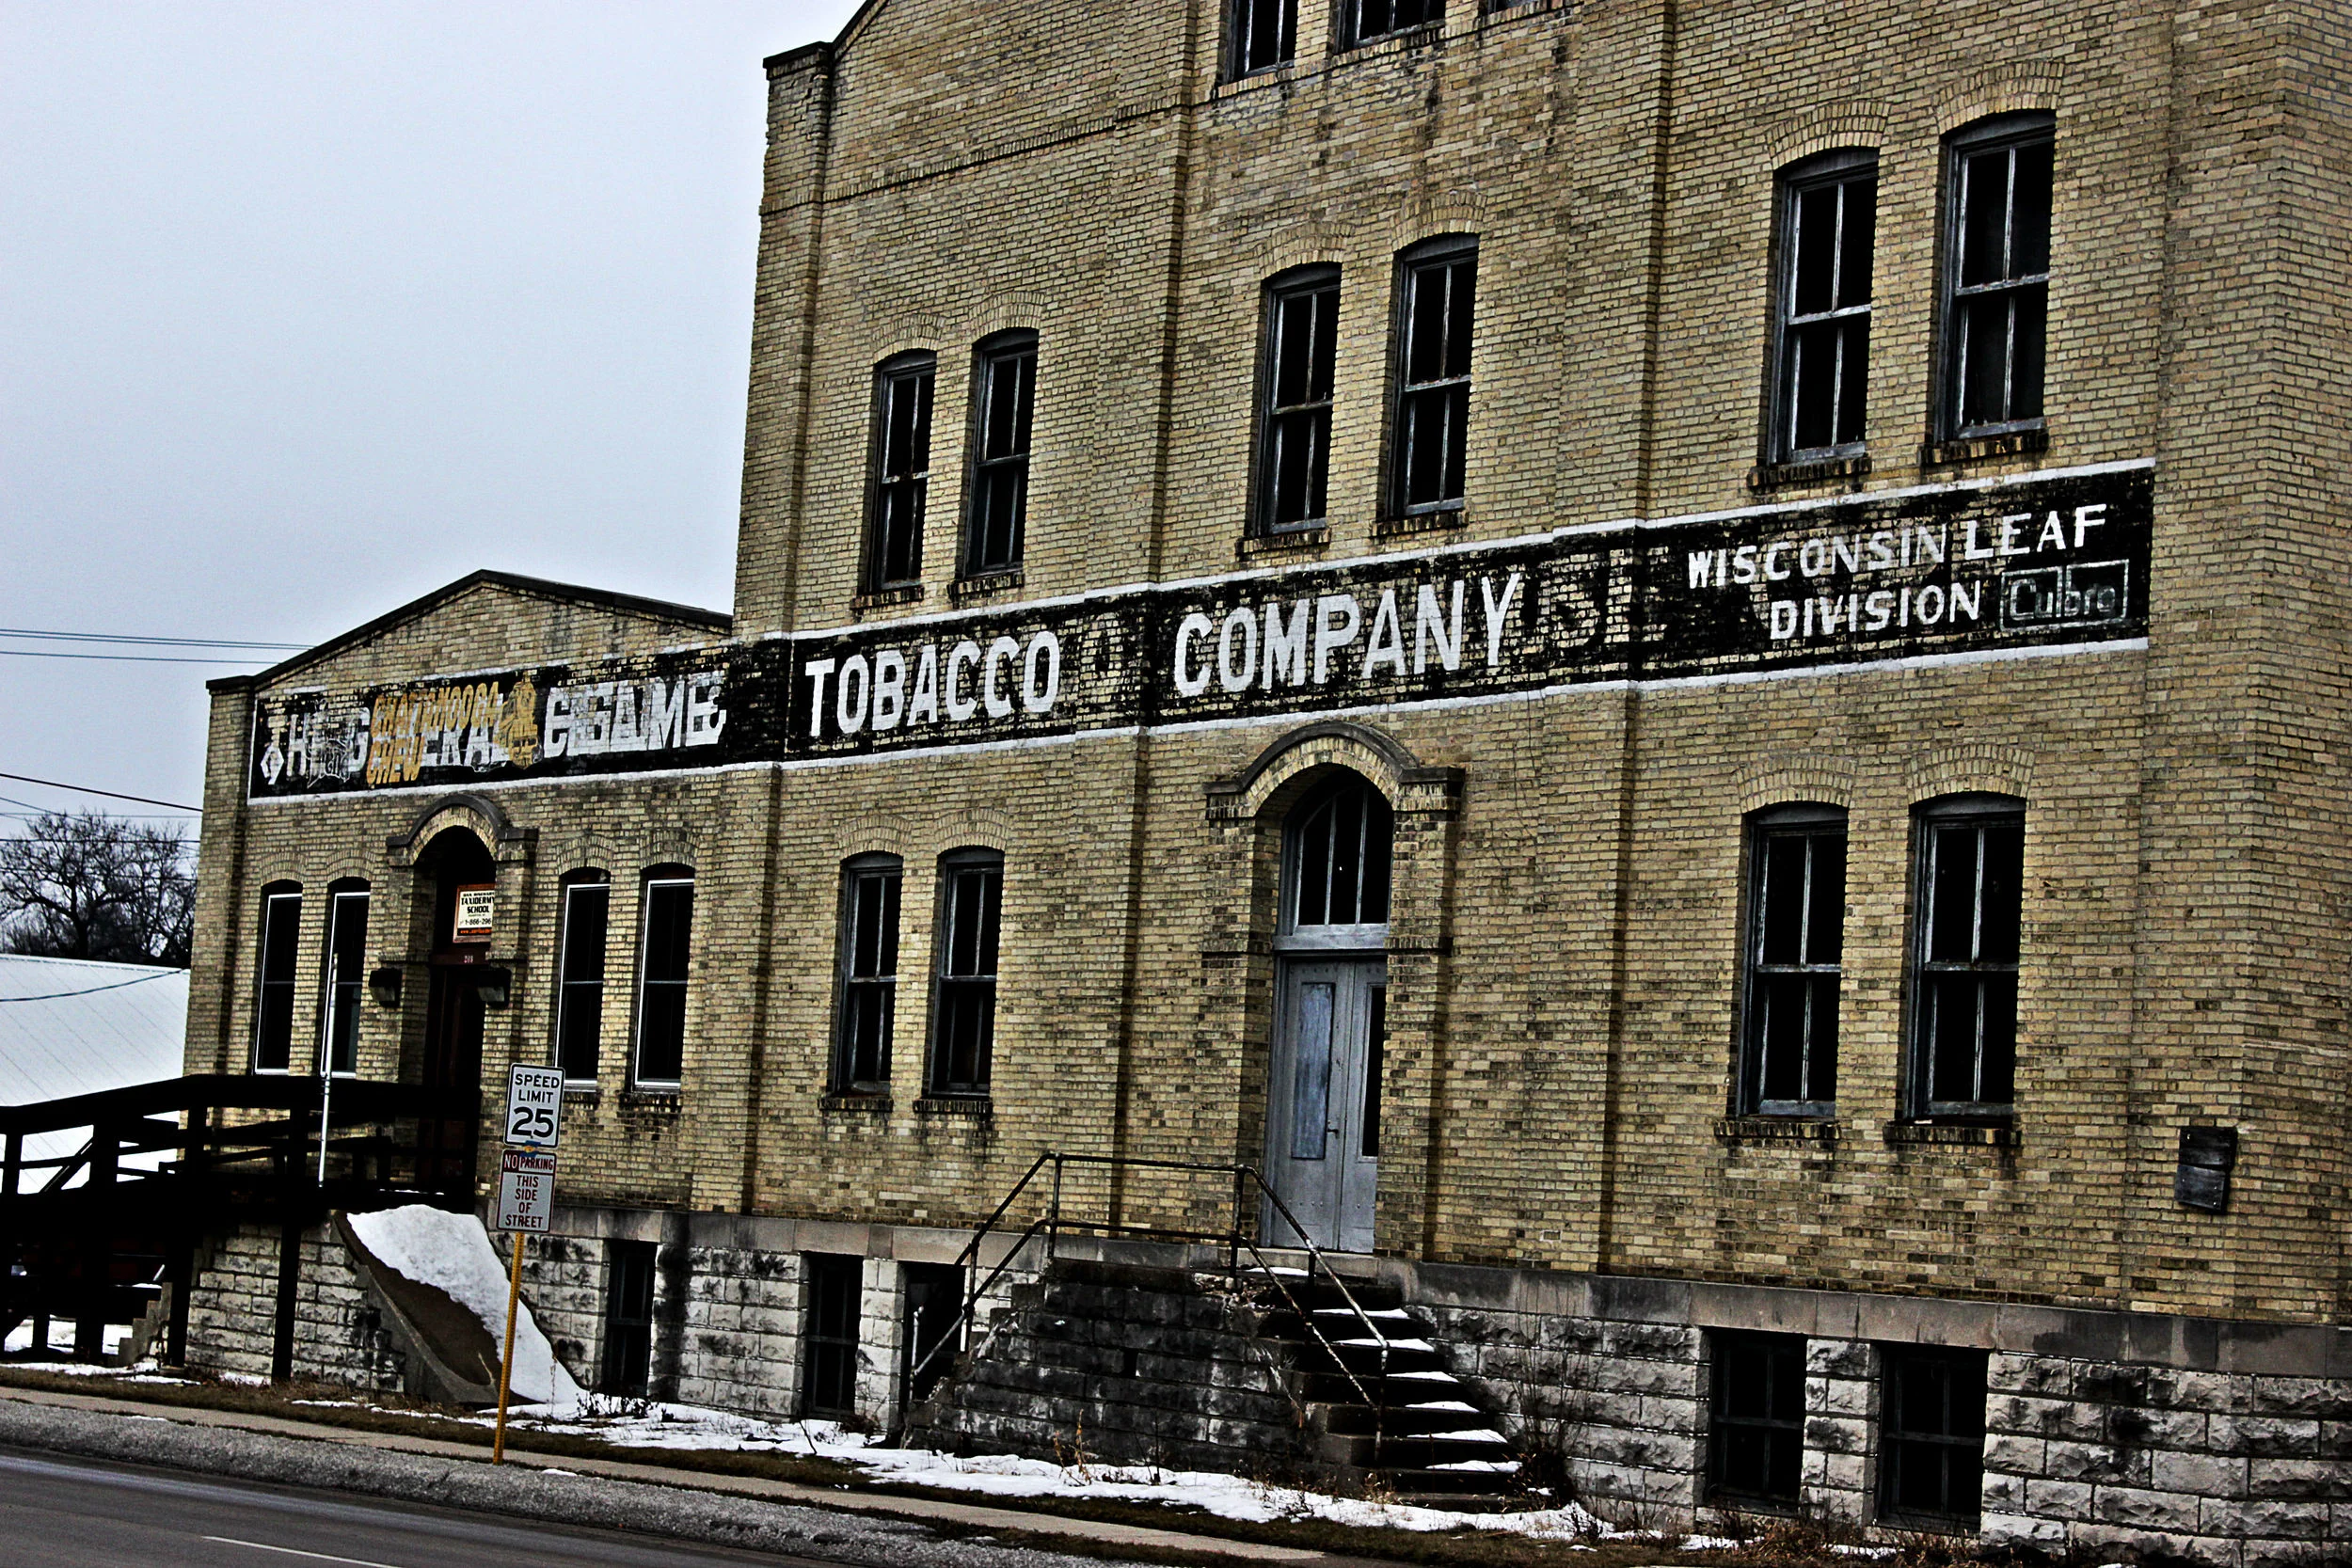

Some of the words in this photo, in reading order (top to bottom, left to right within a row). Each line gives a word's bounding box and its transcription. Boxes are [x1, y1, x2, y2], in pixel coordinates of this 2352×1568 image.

[1688, 521, 1947, 590] WISCONSIN
[1965, 503, 2107, 561] LEAF
[1769, 579, 1981, 641] DIVISION
[805, 629, 1060, 738] TOBACCO
[1173, 572, 1521, 699] COMPANY
[366, 736, 425, 784] CHEW
[467, 905, 490, 913] SCHOOL
[515, 1073, 560, 1089] SPEED
[518, 1089, 554, 1103] LIMIT
[511, 1106, 554, 1138] 25
[504, 1154, 517, 1169] NO
[519, 1156, 554, 1171] PARKING
[516, 1175, 539, 1188] THIS
[515, 1188, 538, 1201] SIDE
[518, 1202, 532, 1213] OF
[505, 1214, 543, 1228] STREET
